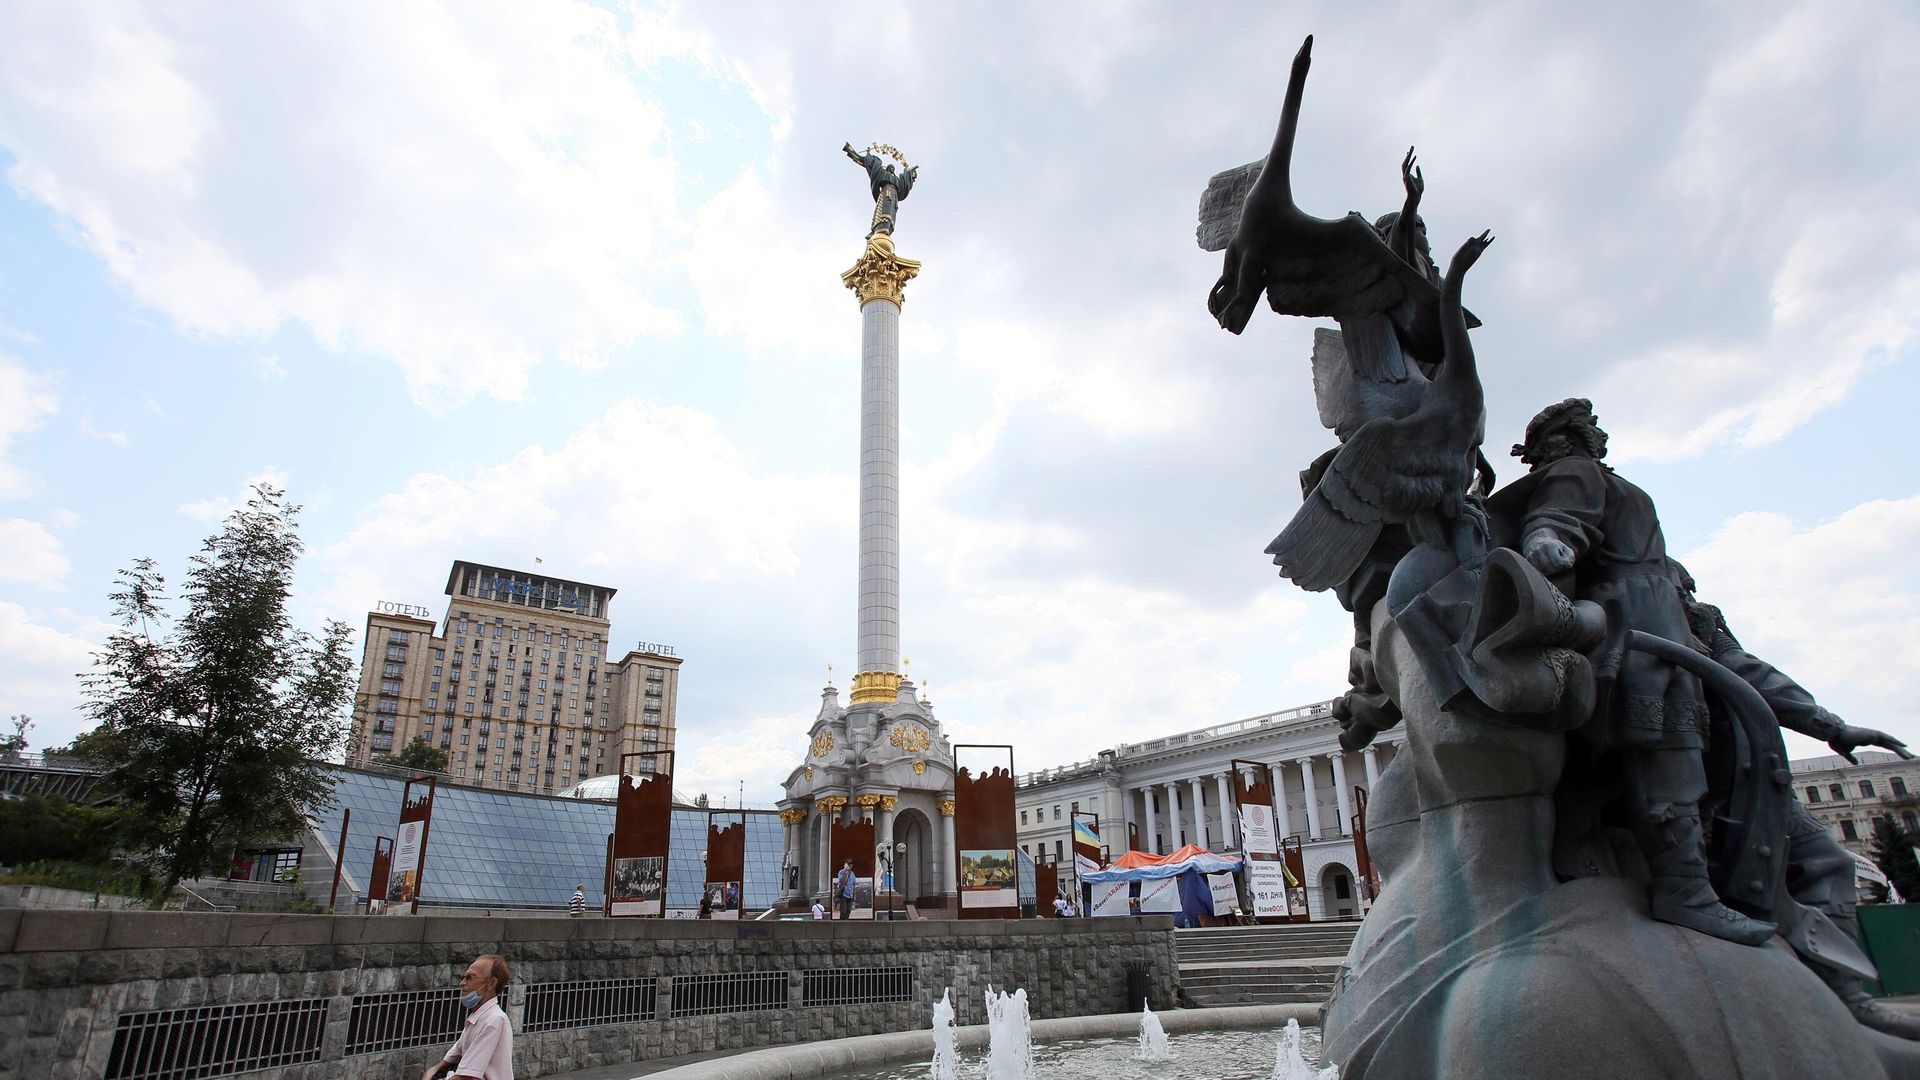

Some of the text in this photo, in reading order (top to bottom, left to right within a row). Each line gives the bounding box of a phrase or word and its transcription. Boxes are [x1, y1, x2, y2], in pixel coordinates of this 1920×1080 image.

[377, 600, 430, 617] ГОТЕЛЬ
[638, 641, 676, 655] HOTEL
[1258, 891, 1268, 900] 161
